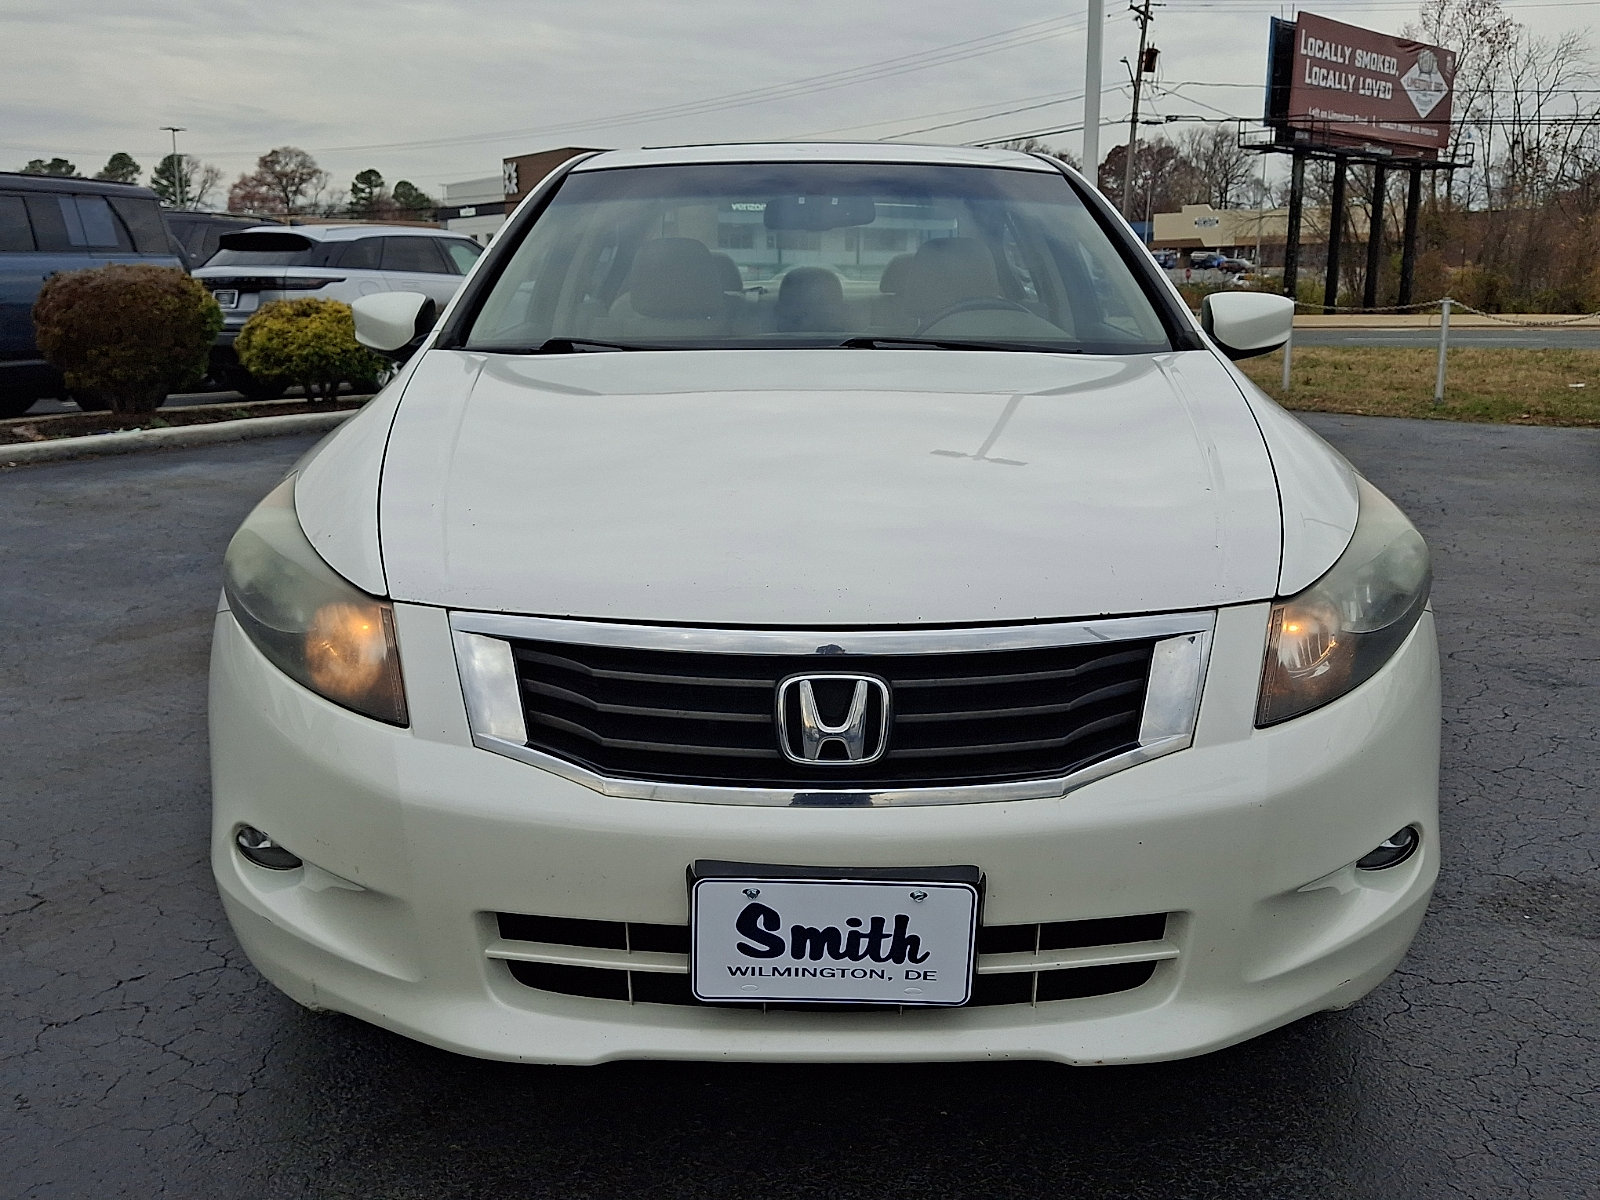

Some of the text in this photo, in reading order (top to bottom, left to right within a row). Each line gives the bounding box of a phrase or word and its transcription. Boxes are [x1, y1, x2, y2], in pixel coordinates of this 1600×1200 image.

[1301, 29, 1400, 77] LOCALLY SMOKED,
[1305, 59, 1355, 92] LOCALLY
[1359, 77, 1393, 99] LOVED
[735, 902, 931, 965] Smith
[726, 965, 938, 982] WILMINGTON, DE
